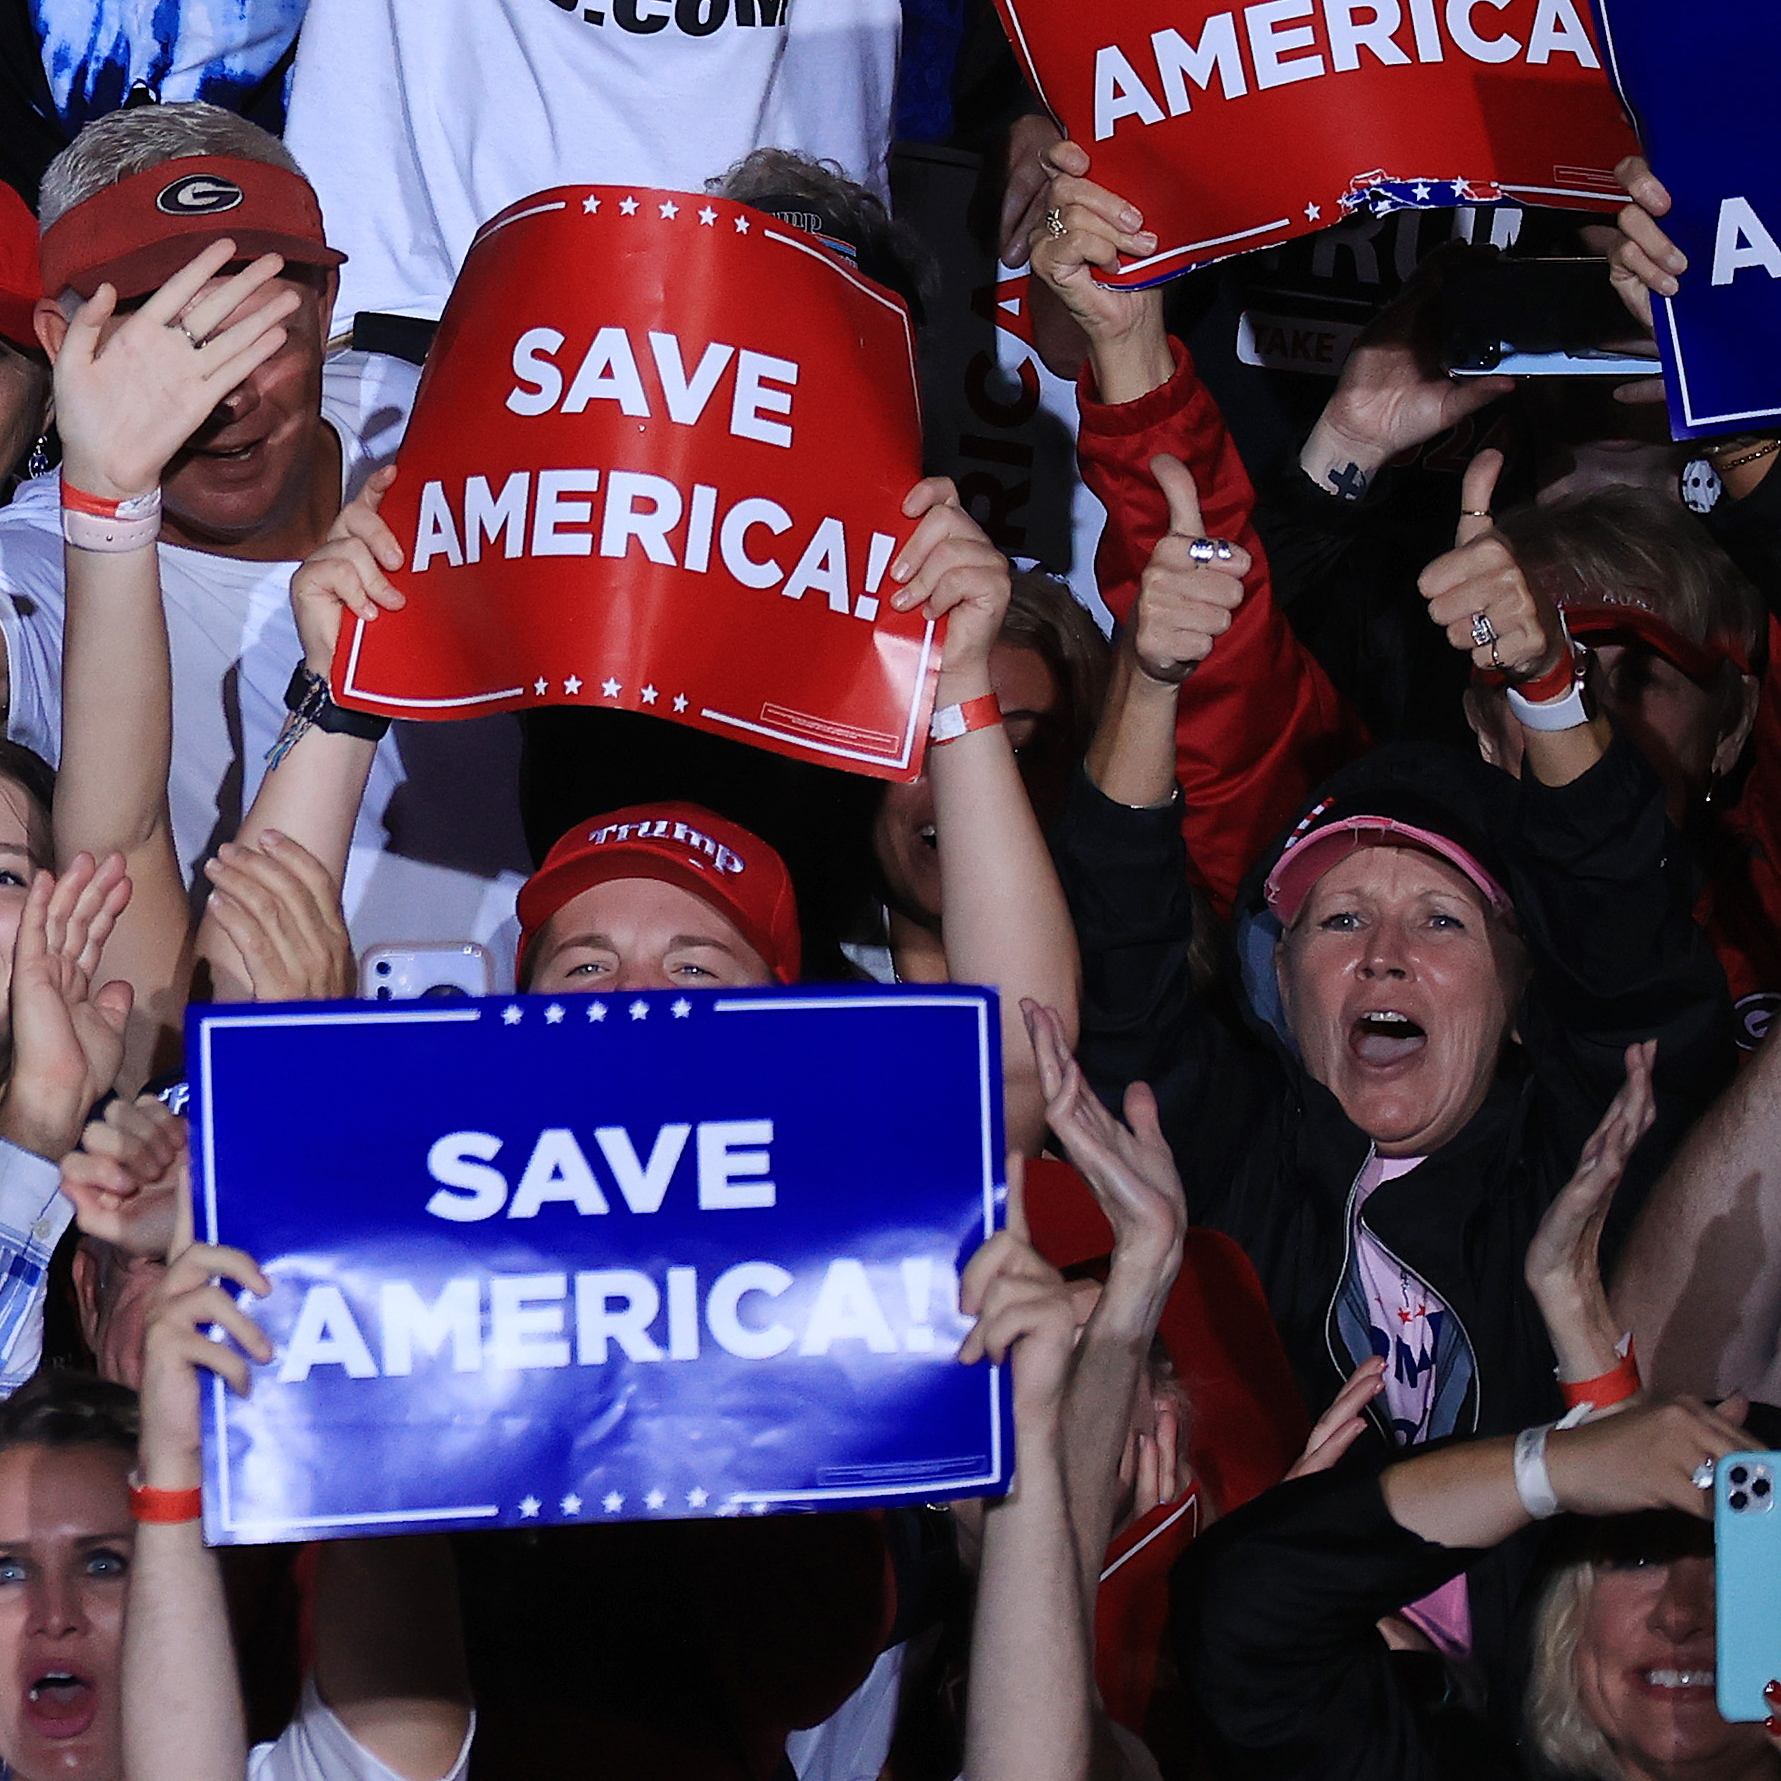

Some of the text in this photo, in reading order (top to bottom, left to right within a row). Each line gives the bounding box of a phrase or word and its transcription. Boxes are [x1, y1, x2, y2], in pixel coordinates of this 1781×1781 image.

[506, 326, 801, 450] SAVE
[411, 467, 898, 623] AMERICA!
[587, 818, 745, 877] Trump
[426, 1118, 777, 1223] SAVE
[277, 1256, 938, 1383] AMERICA!
